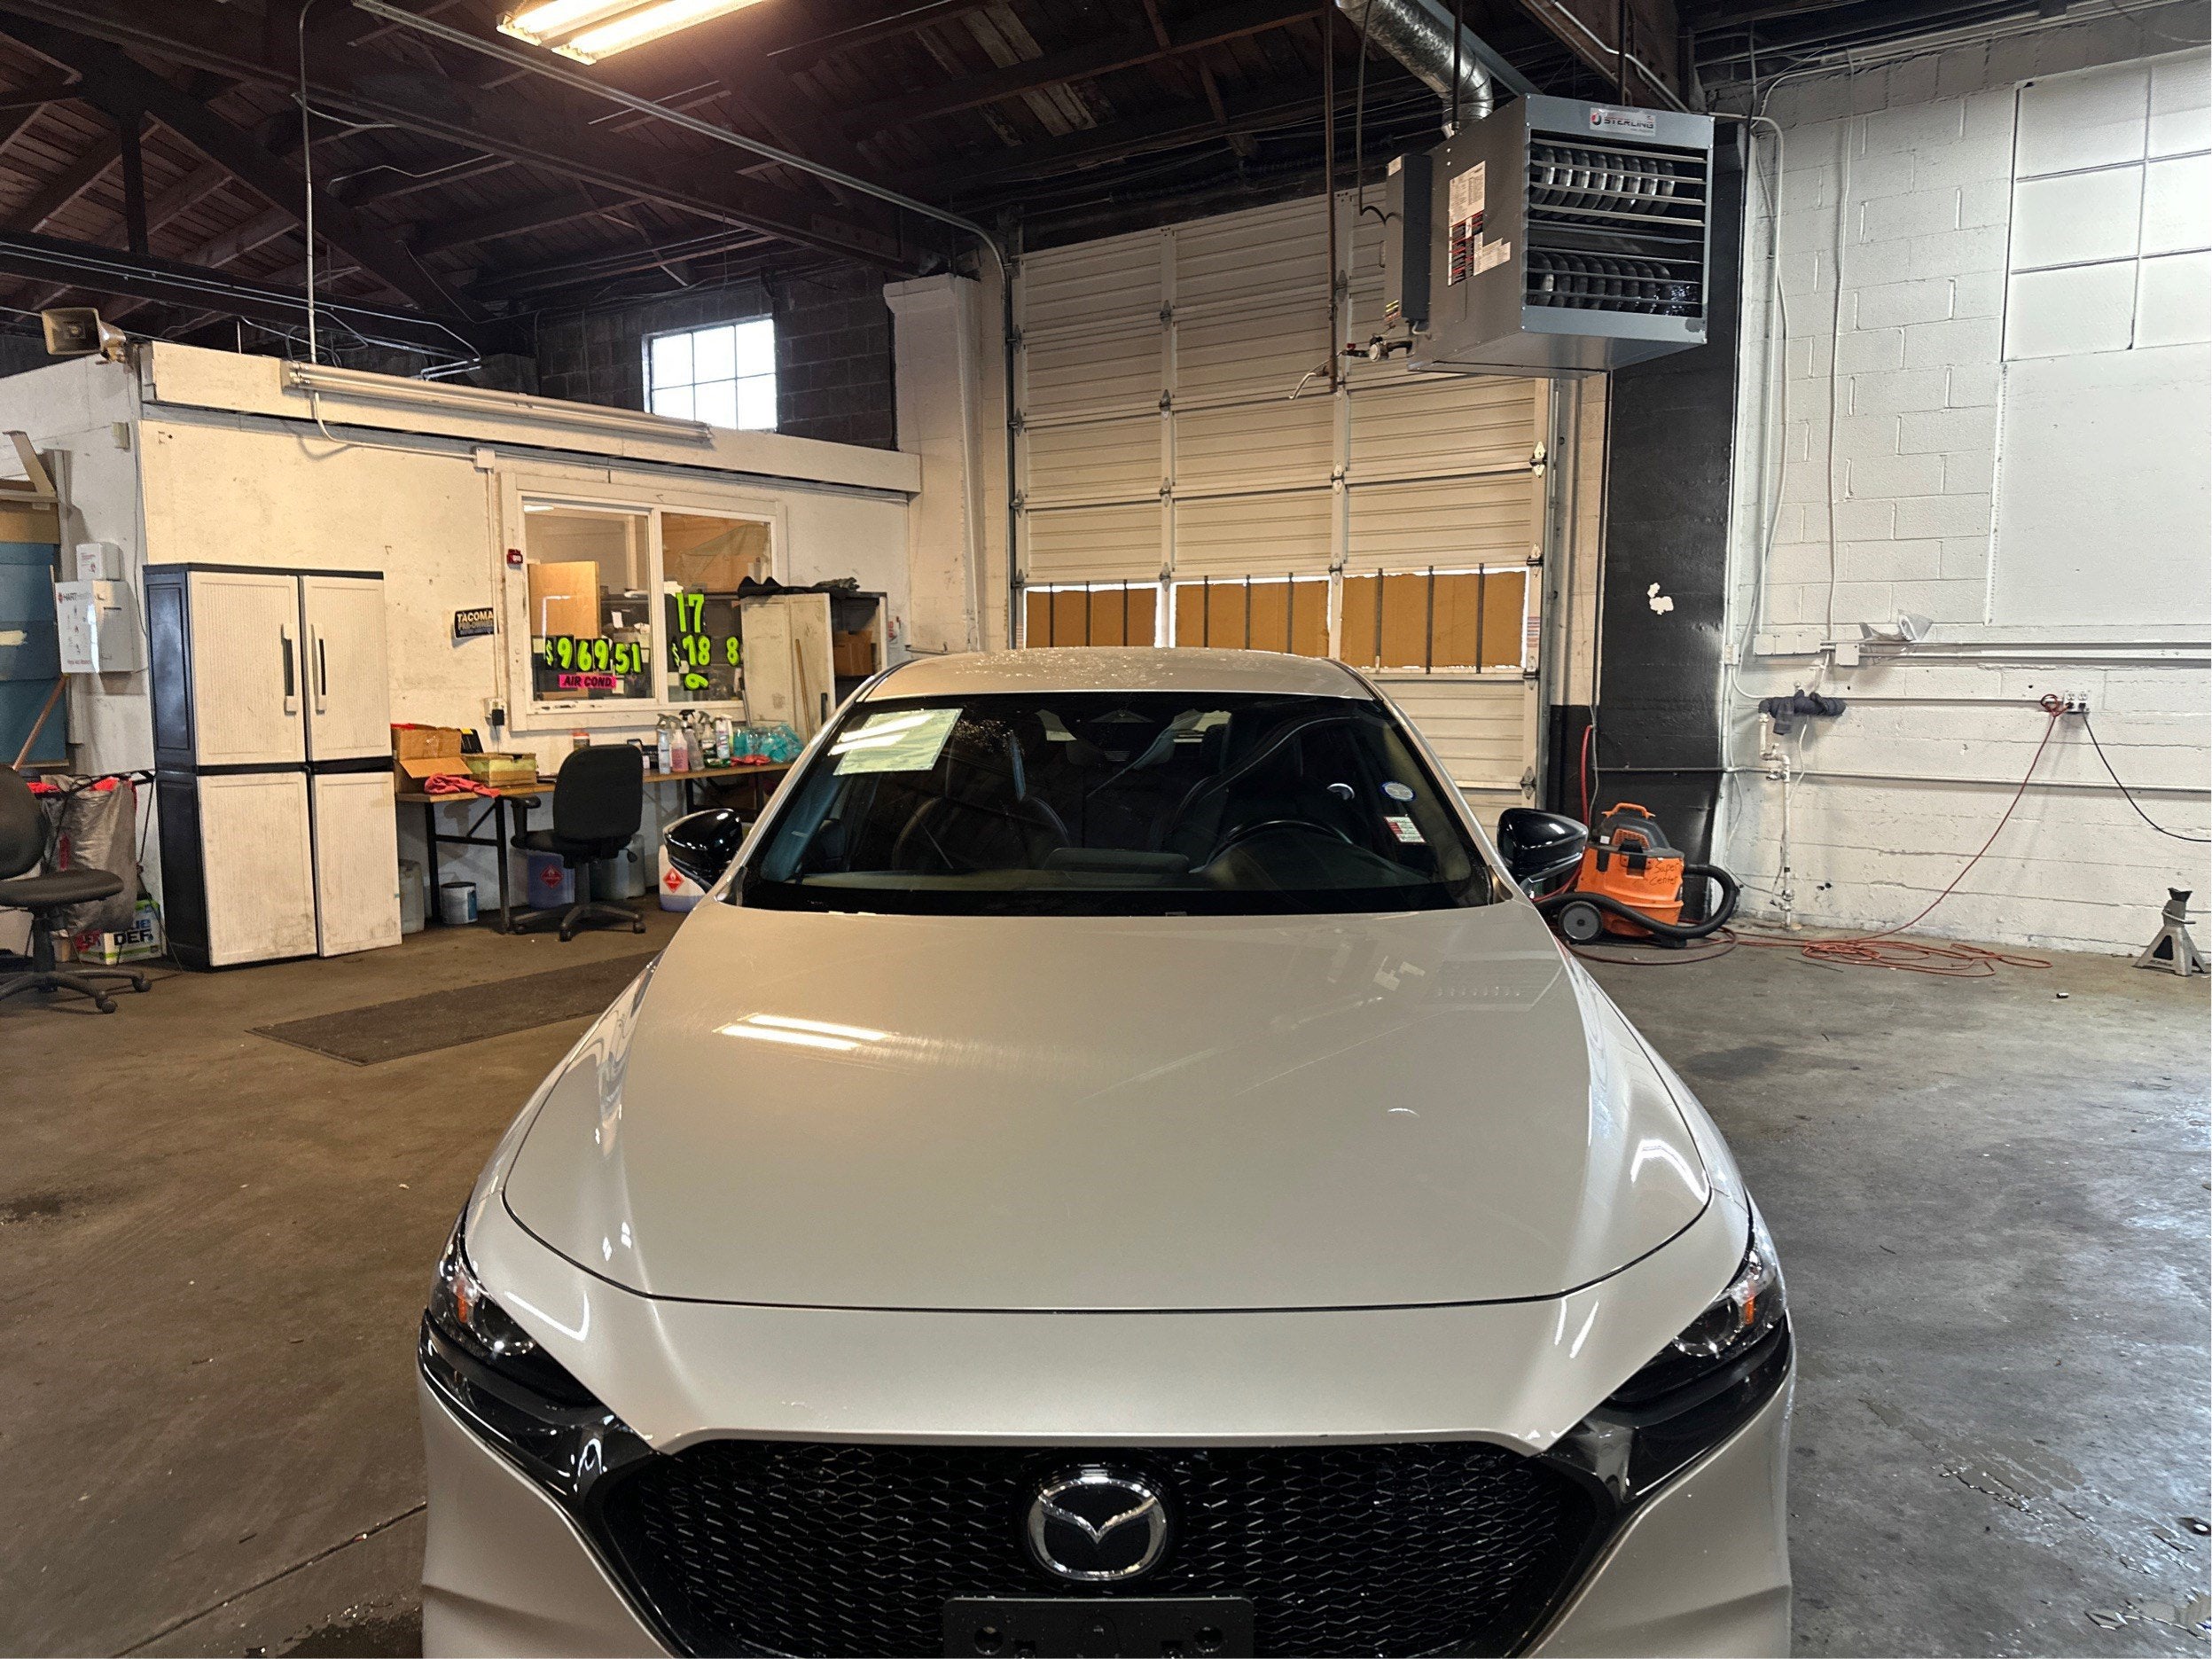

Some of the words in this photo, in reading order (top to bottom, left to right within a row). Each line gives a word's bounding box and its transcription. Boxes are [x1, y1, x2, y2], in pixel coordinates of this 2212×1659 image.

[1604, 119, 1654, 129] STERLING
[457, 611, 494, 623] TACOMA
[676, 592, 705, 633] 17
[562, 676, 582, 688] AIR
